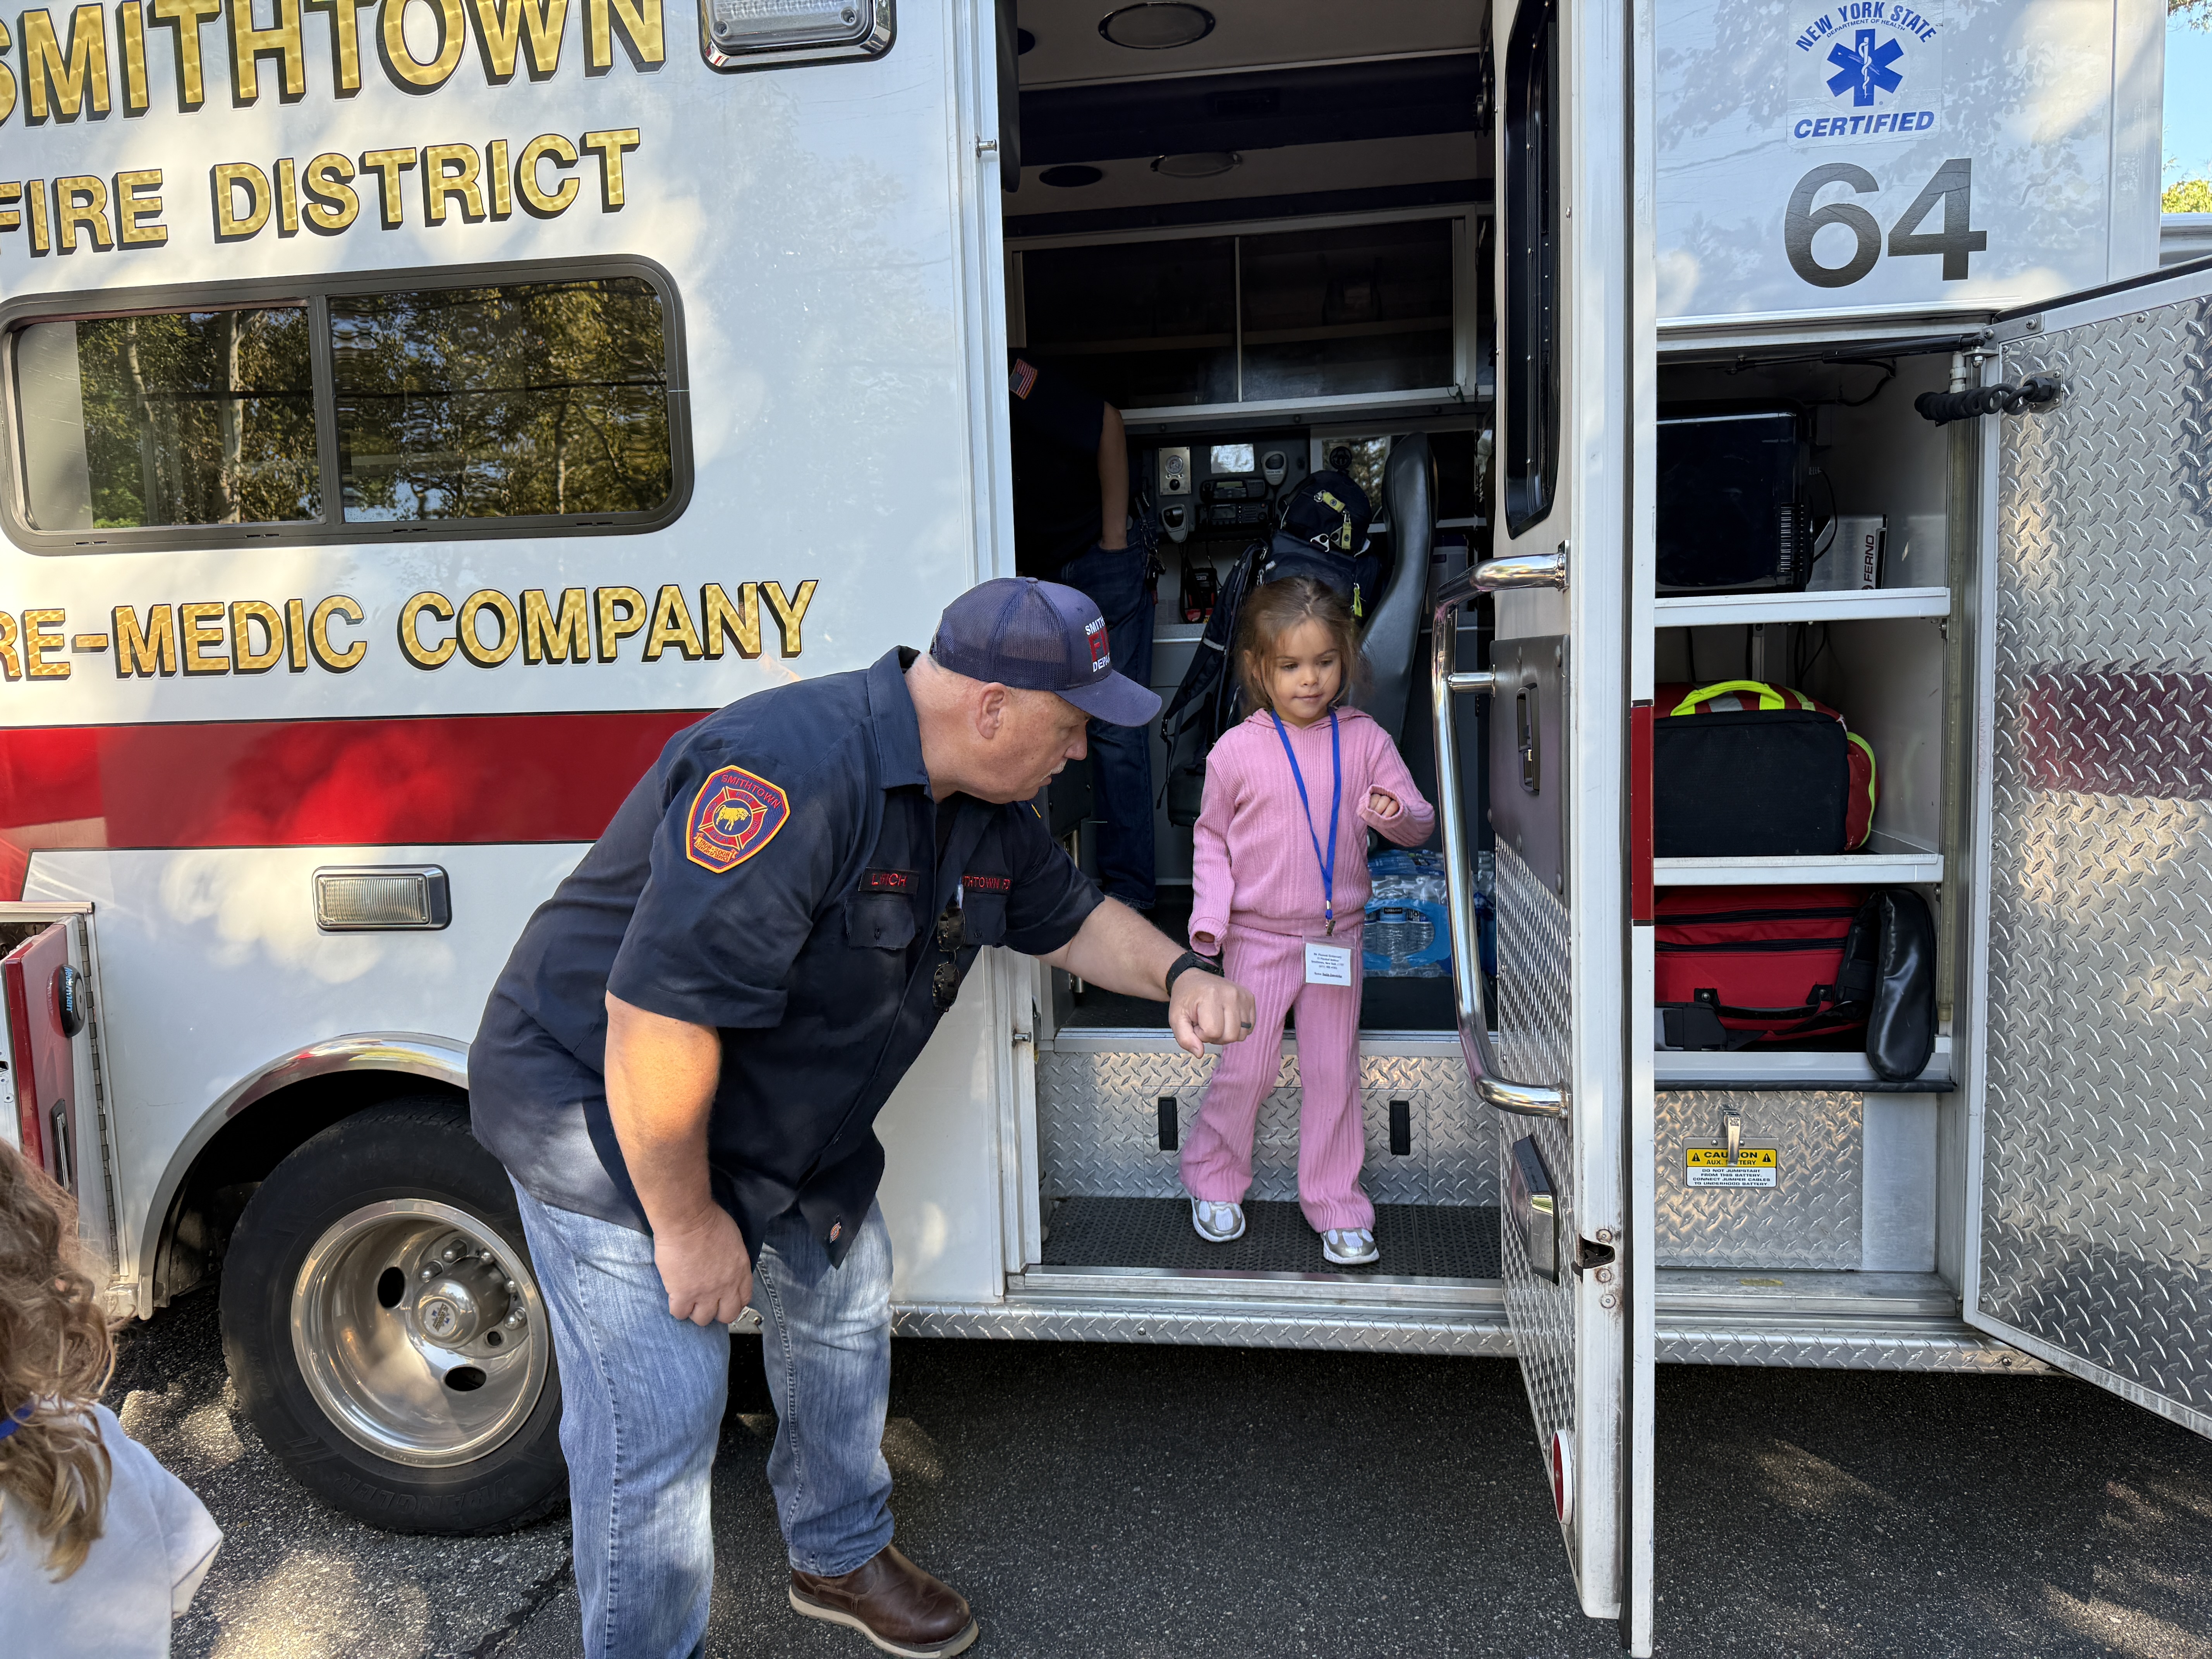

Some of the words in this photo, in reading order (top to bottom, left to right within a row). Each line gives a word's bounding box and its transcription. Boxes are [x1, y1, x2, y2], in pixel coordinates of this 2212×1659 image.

[1795, 15, 1832, 52] NEW
[1838, 1, 1884, 21] YORK
[1890, 5, 1937, 43] STATE
[1826, 19, 1869, 38] DEPARTMENT
[1881, 19, 1906, 31] HEALTH
[0, 0, 665, 128] MITHTOWN
[1793, 111, 1935, 139] CERTIFIED
[210, 127, 641, 244] DISTRICT
[1784, 158, 1987, 288] 64
[1863, 534, 1874, 582] FERNO
[397, 579, 819, 669] COMPANY
[721, 774, 781, 809] SMITHTOWN
